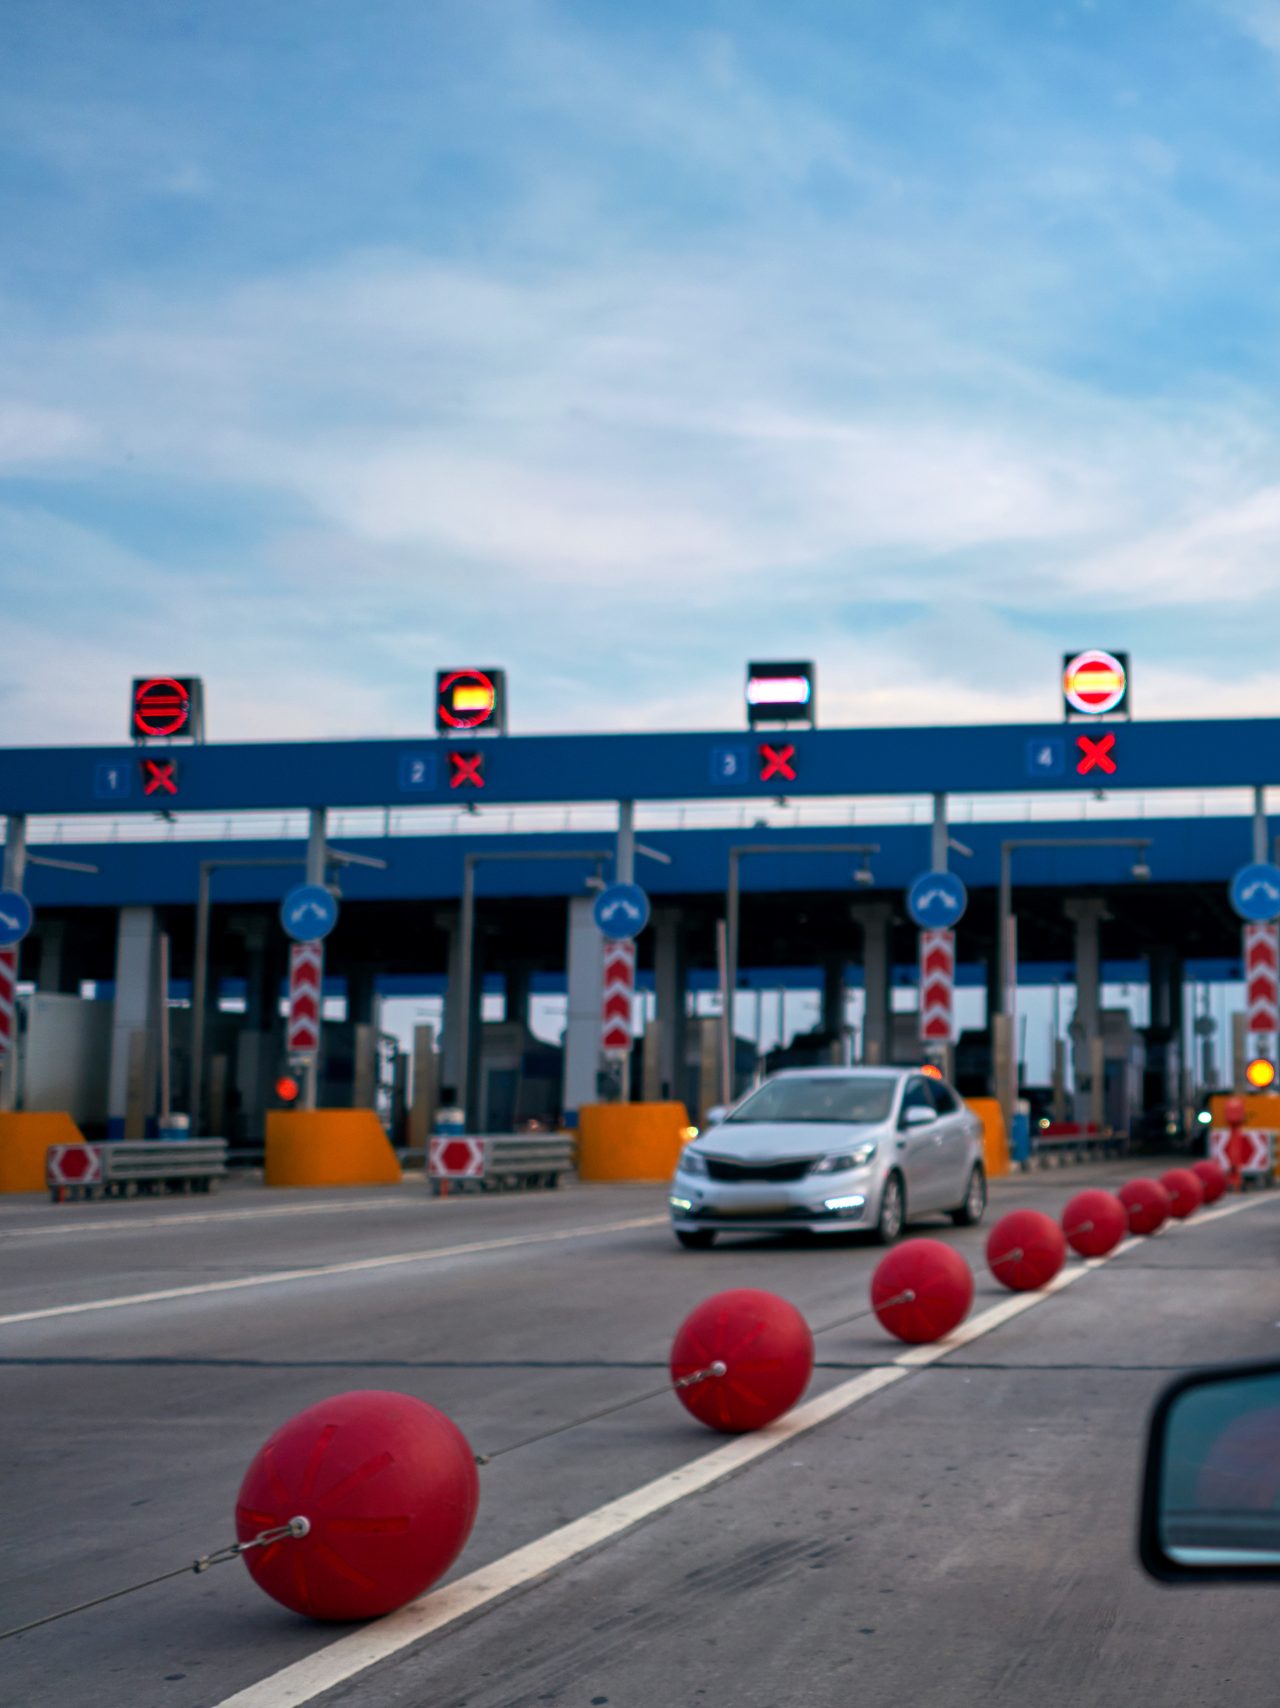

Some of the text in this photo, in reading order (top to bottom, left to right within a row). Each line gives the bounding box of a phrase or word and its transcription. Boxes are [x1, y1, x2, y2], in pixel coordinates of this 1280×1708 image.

[724, 754, 737, 775] 3
[1038, 746, 1052, 767] 4
[107, 768, 118, 789] 1
[412, 761, 425, 782] 2
